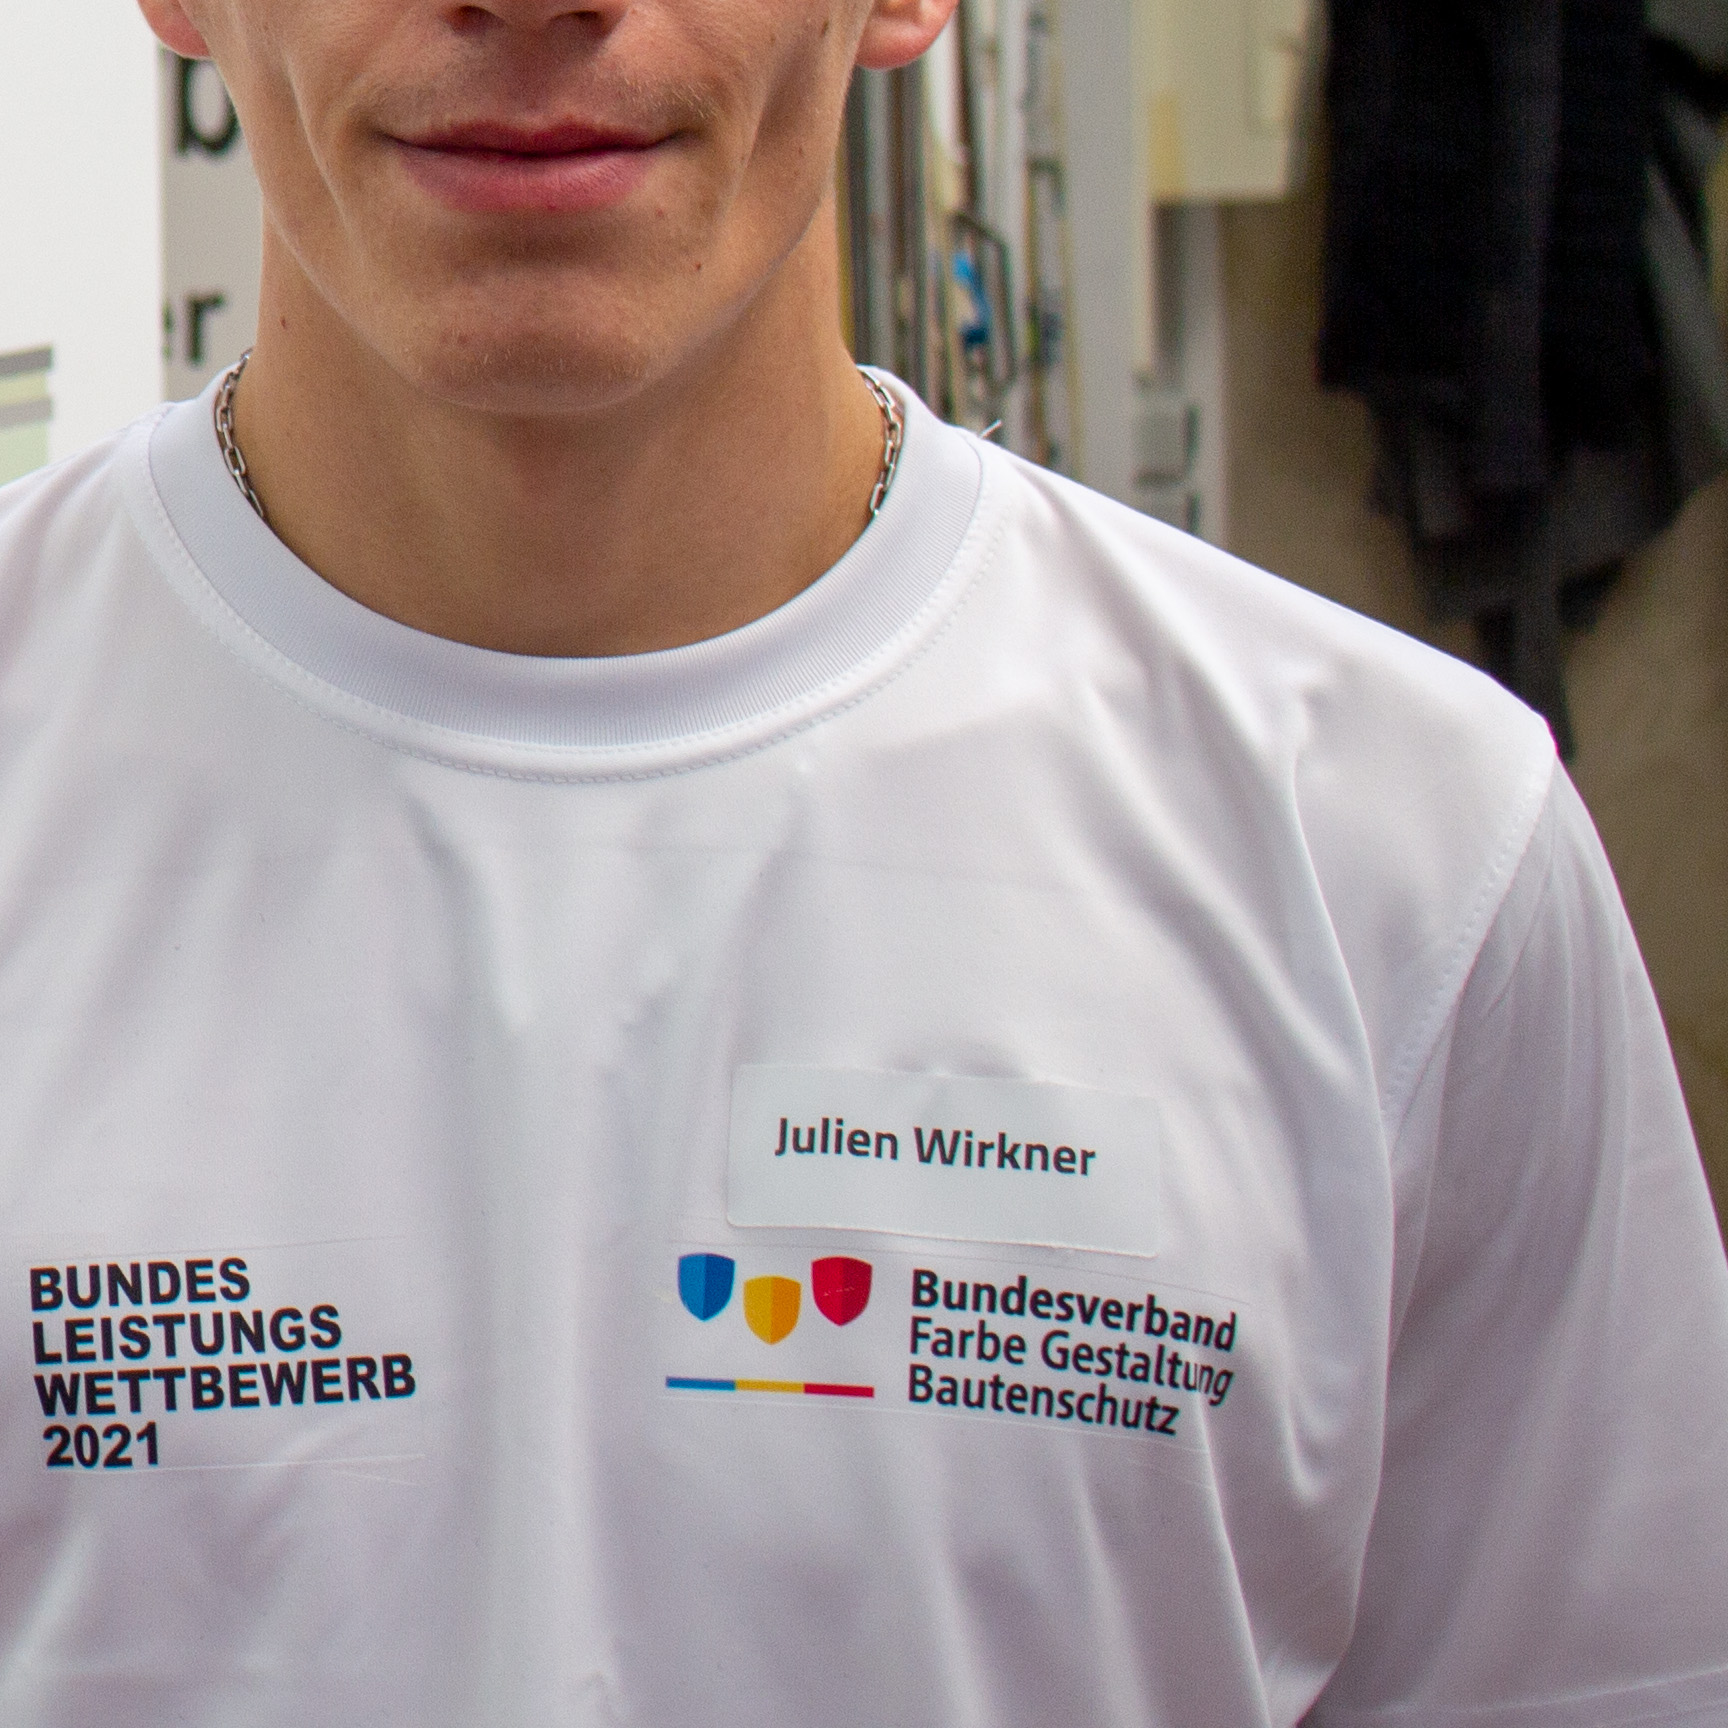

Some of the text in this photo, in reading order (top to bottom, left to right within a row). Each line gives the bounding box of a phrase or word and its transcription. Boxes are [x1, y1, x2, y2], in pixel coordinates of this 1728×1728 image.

[773, 1117, 1097, 1177] Julien Wirkner
[29, 1256, 252, 1313] BUNDES
[911, 1268, 1237, 1354] Bundesverband
[32, 1303, 343, 1365] LEISTUNGS
[909, 1316, 1235, 1407] Farbe Gestaltung
[33, 1353, 417, 1417] WETTBEWERB
[908, 1363, 1180, 1437] Bautenschutz
[42, 1421, 161, 1470] 2021
